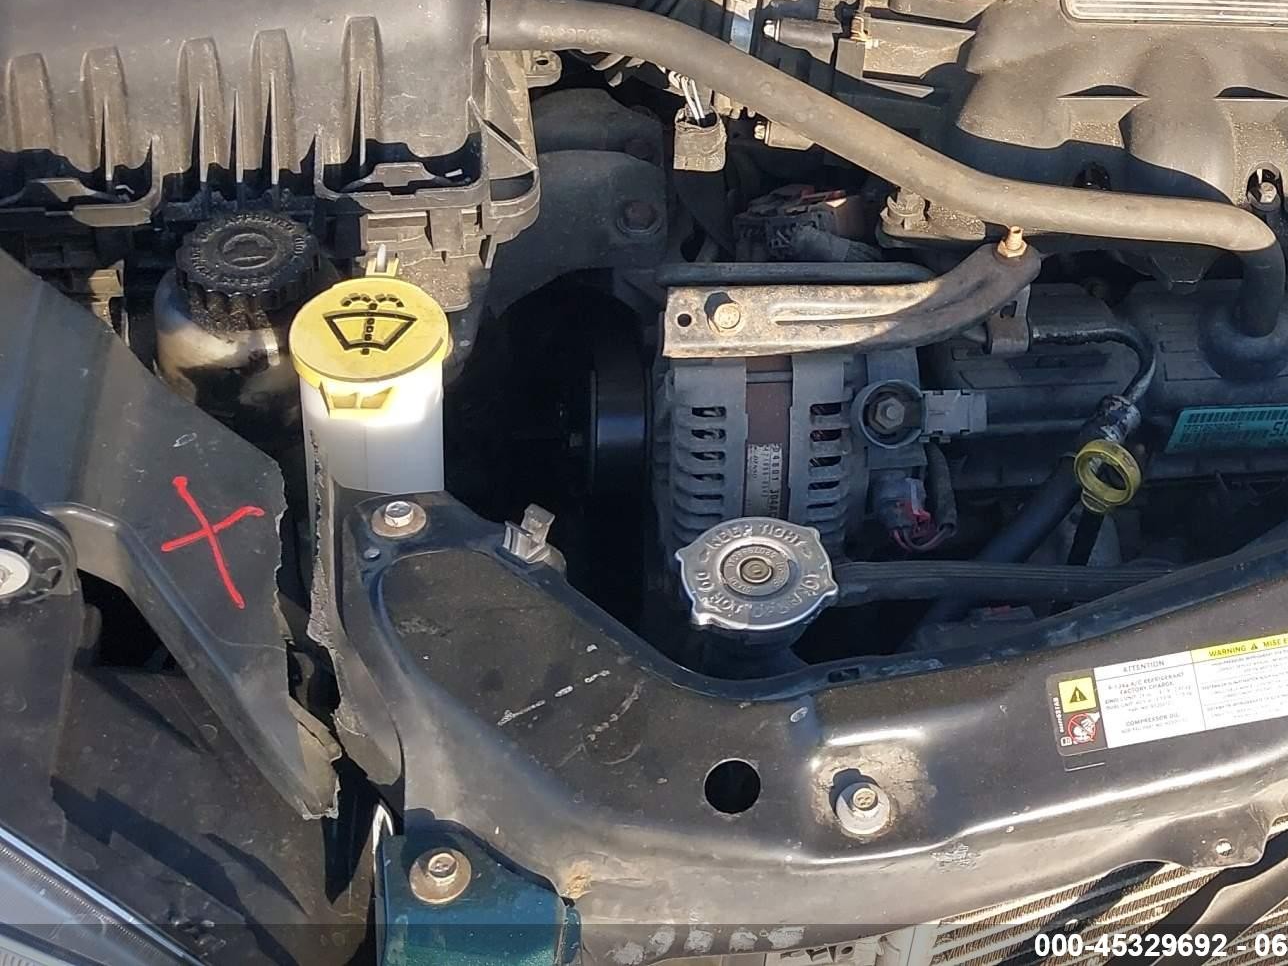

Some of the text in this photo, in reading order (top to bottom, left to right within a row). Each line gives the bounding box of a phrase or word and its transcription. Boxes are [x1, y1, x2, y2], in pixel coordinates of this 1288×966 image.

[1208, 645, 1247, 658] WARNING
[1263, 638, 1281, 648] MISE
[1123, 660, 1165, 673] ATTENTION
